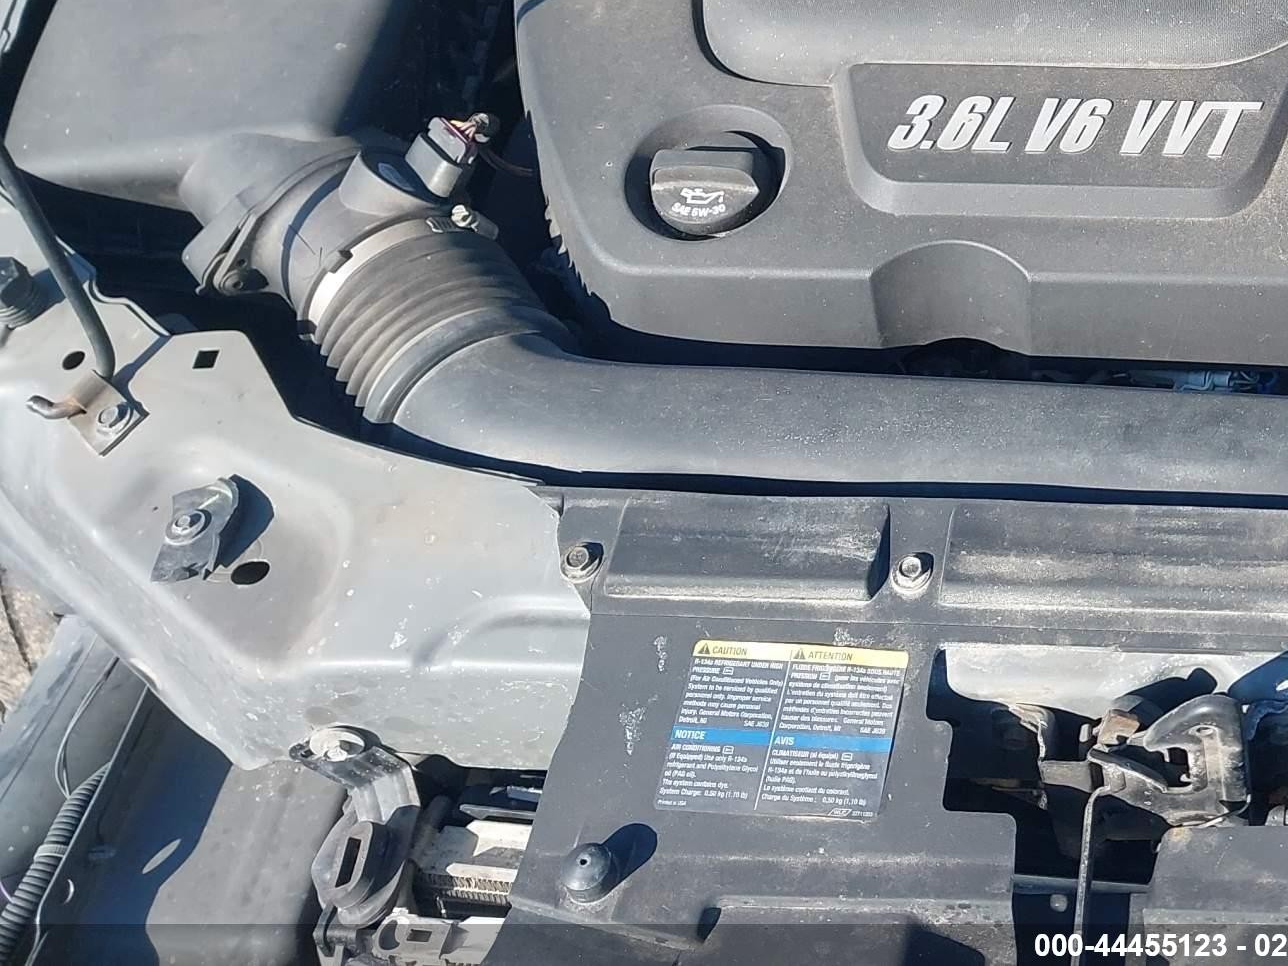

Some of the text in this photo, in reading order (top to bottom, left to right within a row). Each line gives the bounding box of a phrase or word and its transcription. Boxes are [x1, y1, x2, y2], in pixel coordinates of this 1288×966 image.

[887, 94, 1264, 158] 3.6L V6 VVT
[671, 202, 691, 216] SAE
[712, 646, 747, 655] CAUTION
[807, 651, 853, 660] ATTENTION
[674, 729, 706, 739] NOTICE
[774, 736, 794, 745] AVIS
